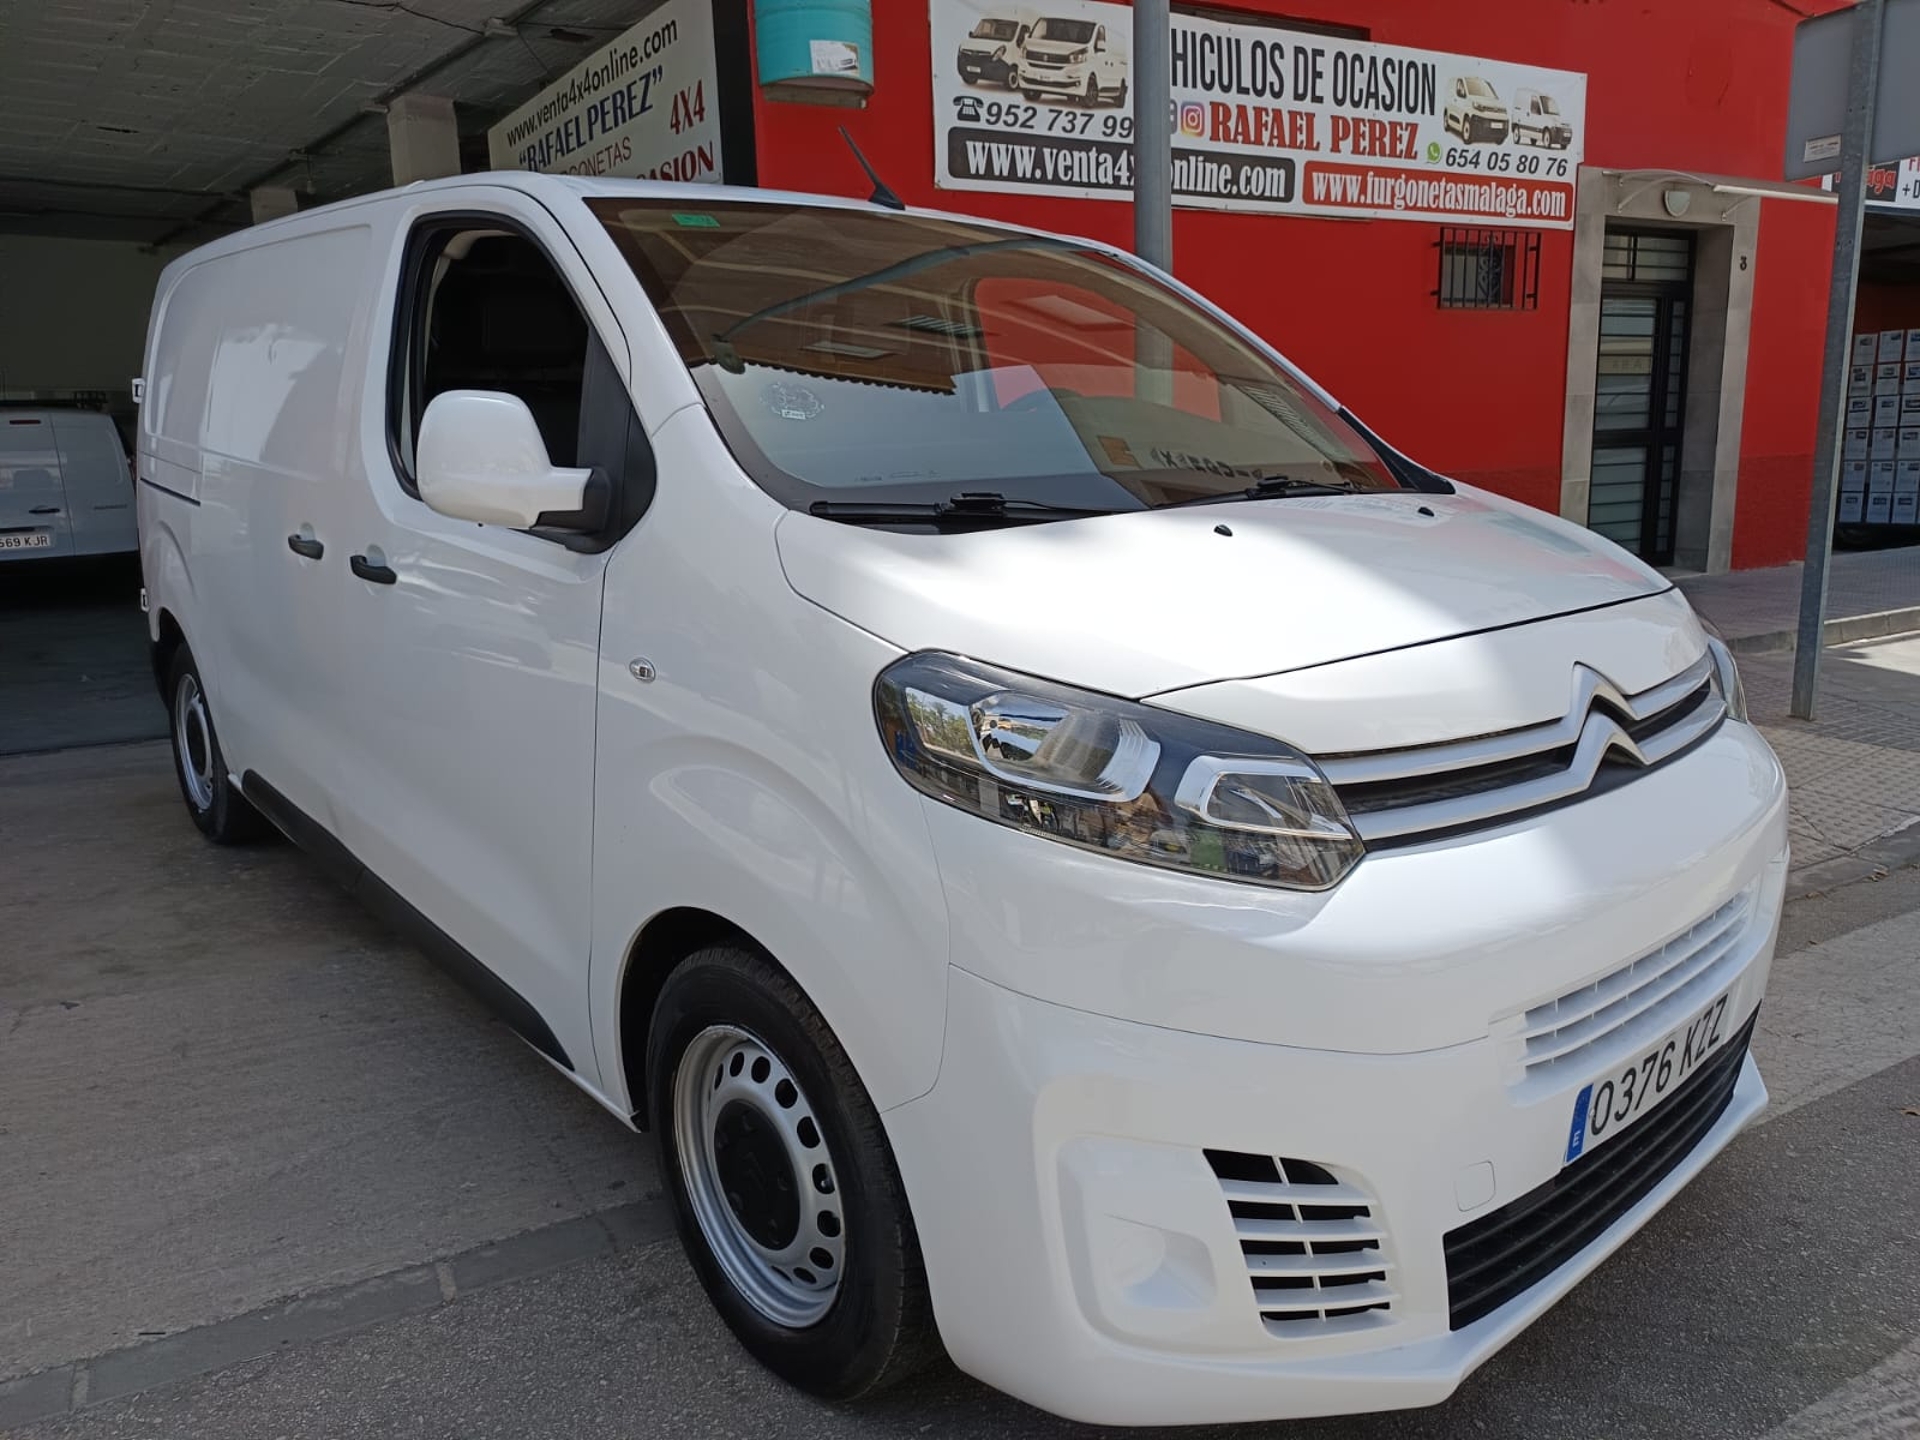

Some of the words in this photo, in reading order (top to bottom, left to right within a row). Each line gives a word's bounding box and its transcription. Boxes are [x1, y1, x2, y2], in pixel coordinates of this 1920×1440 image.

[507, 19, 678, 148] www.venta4x4online.com
[1171, 28, 1285, 99] HICULOS
[1293, 45, 1325, 104] DE
[1333, 51, 1436, 116] OCASION
[669, 79, 706, 135] 4X4
[985, 101, 1037, 130] 952
[1047, 108, 1095, 135] 737
[1209, 100, 1320, 152] RAFAEL
[1329, 114, 1419, 160] PEREZ
[1445, 147, 1481, 169] 654
[1487, 151, 1511, 172] 05
[1516, 154, 1540, 174] 80
[1546, 157, 1568, 177] 76
[1312, 171, 1566, 218] www.furgonetasmalaga.com
[24, 535, 48, 546] KJR
[1591, 1040, 1676, 1136] 0376
[1679, 993, 1729, 1076] KZZ
